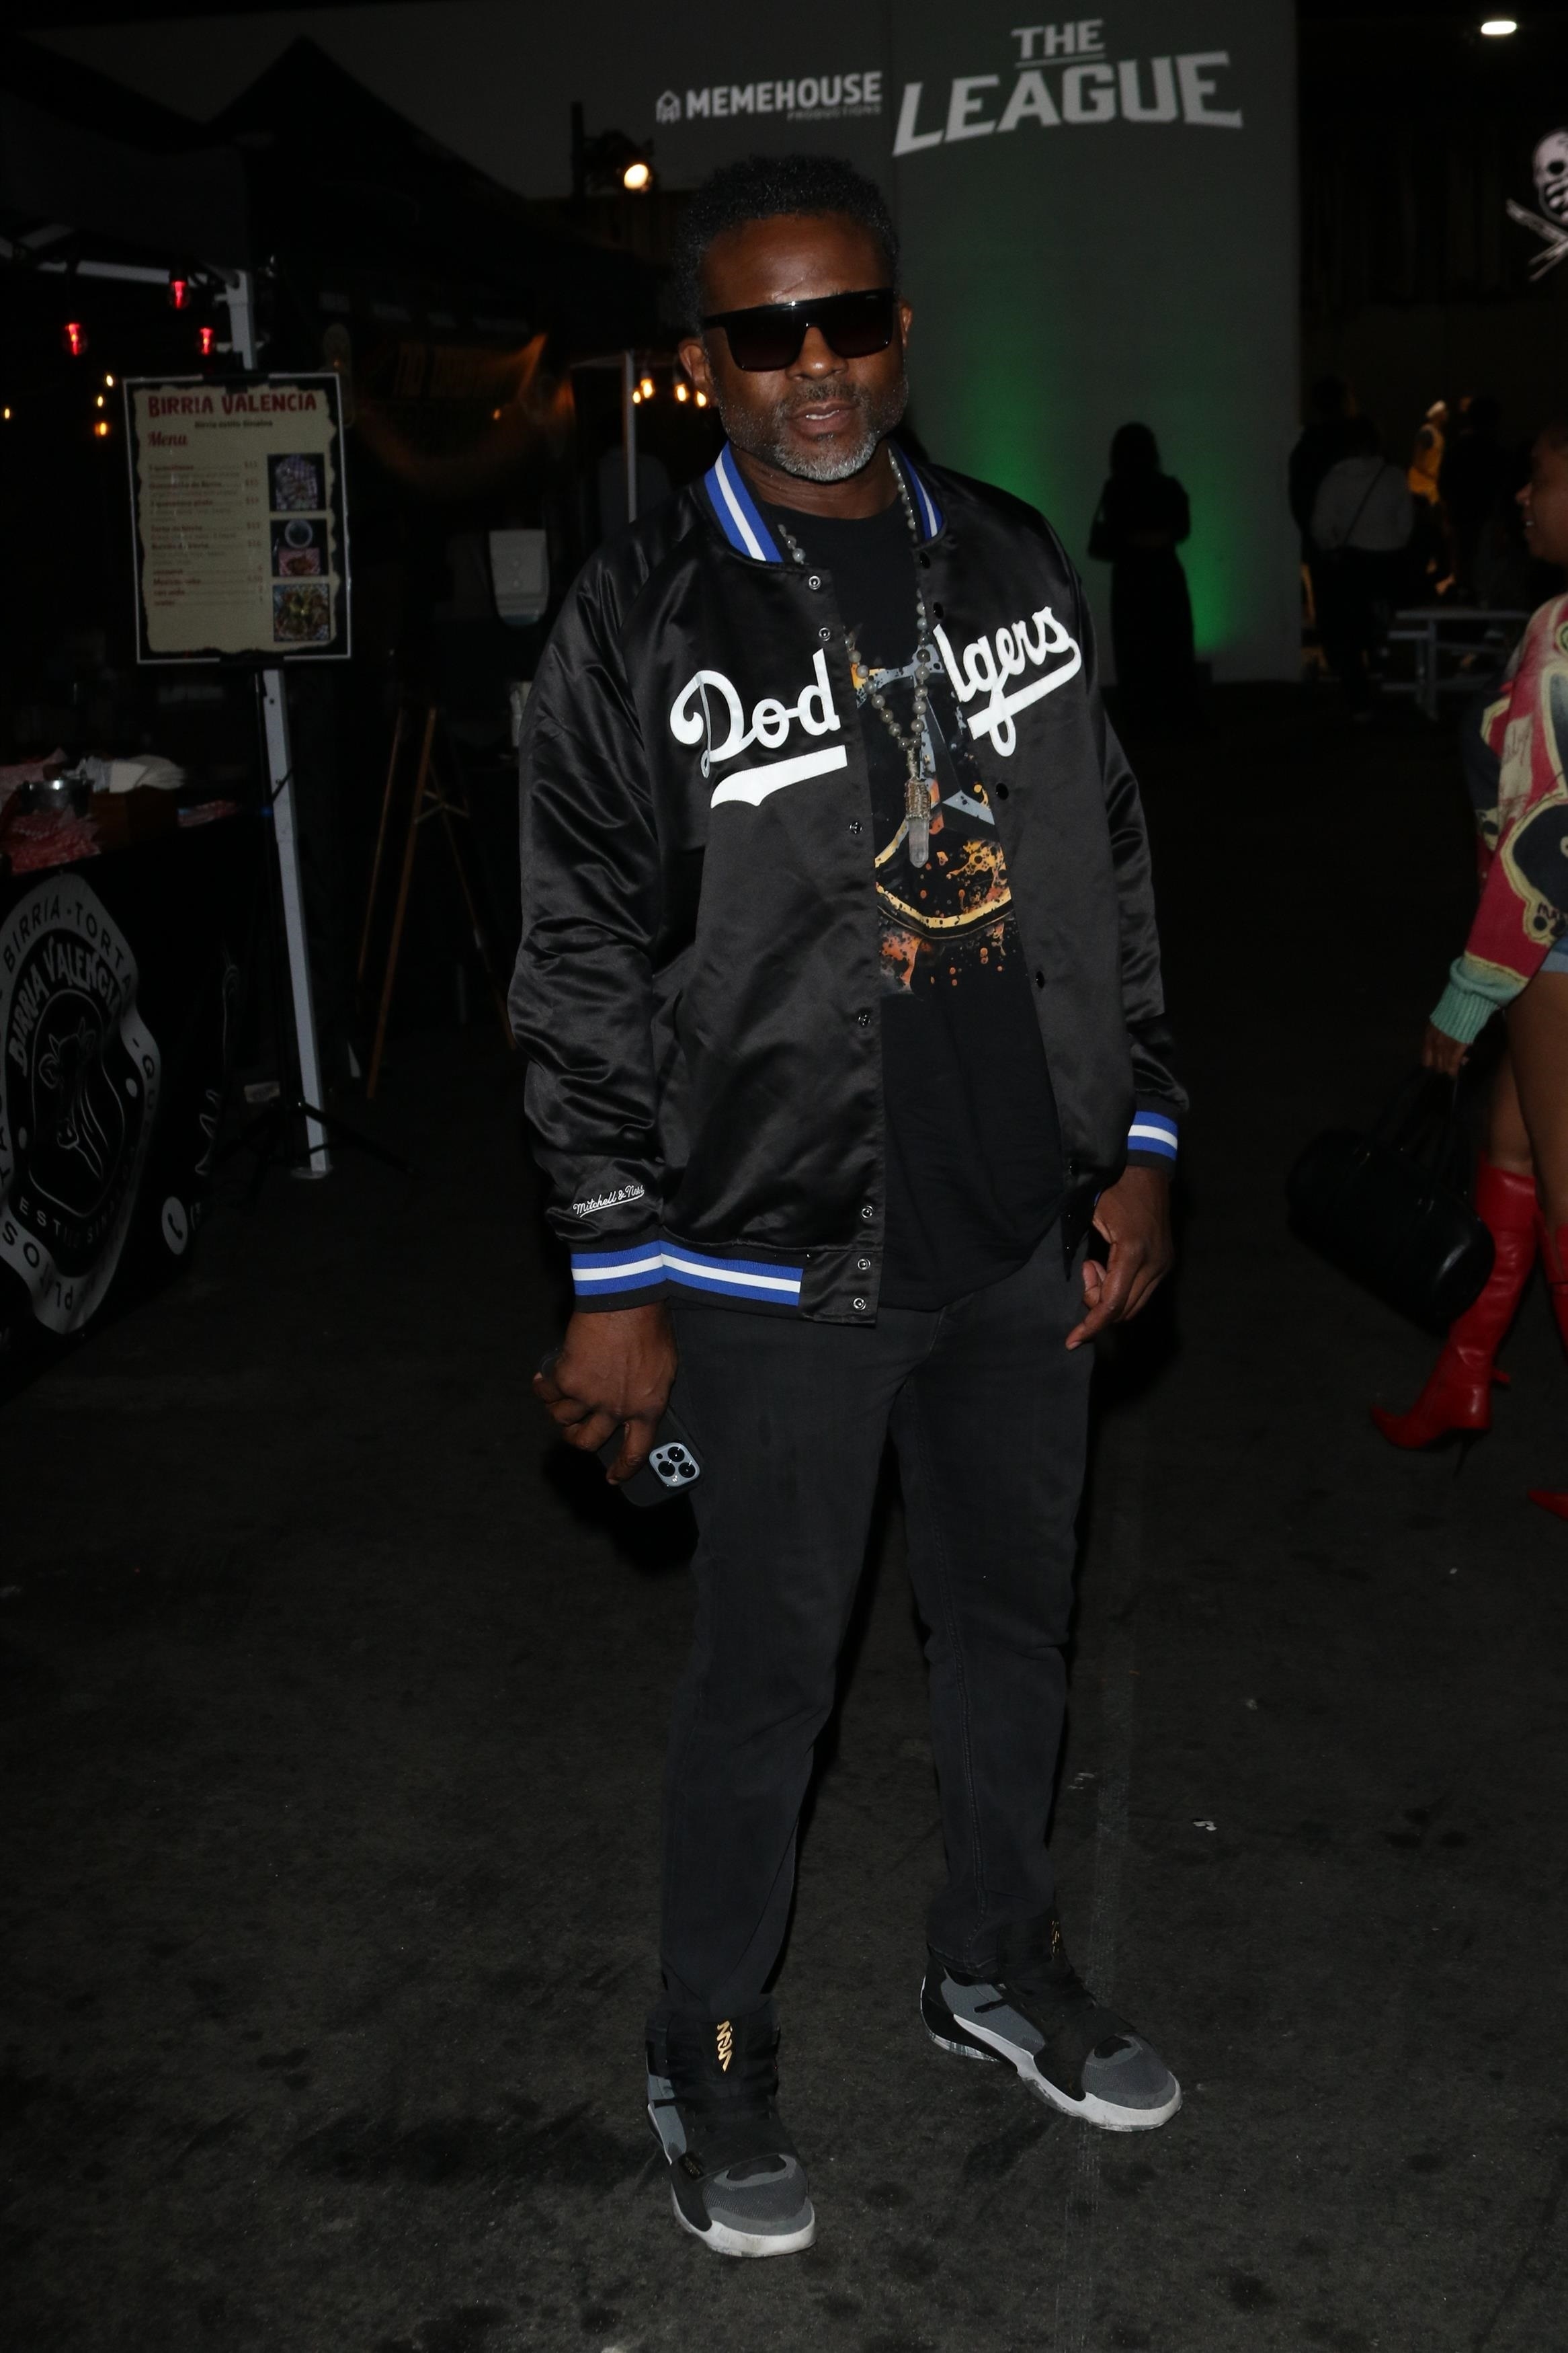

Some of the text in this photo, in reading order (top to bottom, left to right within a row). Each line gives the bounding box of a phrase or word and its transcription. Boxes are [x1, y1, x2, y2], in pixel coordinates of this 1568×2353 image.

[1012, 18, 1104, 59] THE
[686, 71, 882, 118] MEMEHOUSE
[893, 51, 1243, 157] LEAGUE
[148, 393, 317, 417] BIRRIA VALENCIA
[147, 431, 189, 447] Menu
[3, 894, 60, 973] BIRRIA
[8, 934, 122, 1077] BIRRIA VALENCIA
[572, 1184, 646, 1215] Mitchell & Ness
